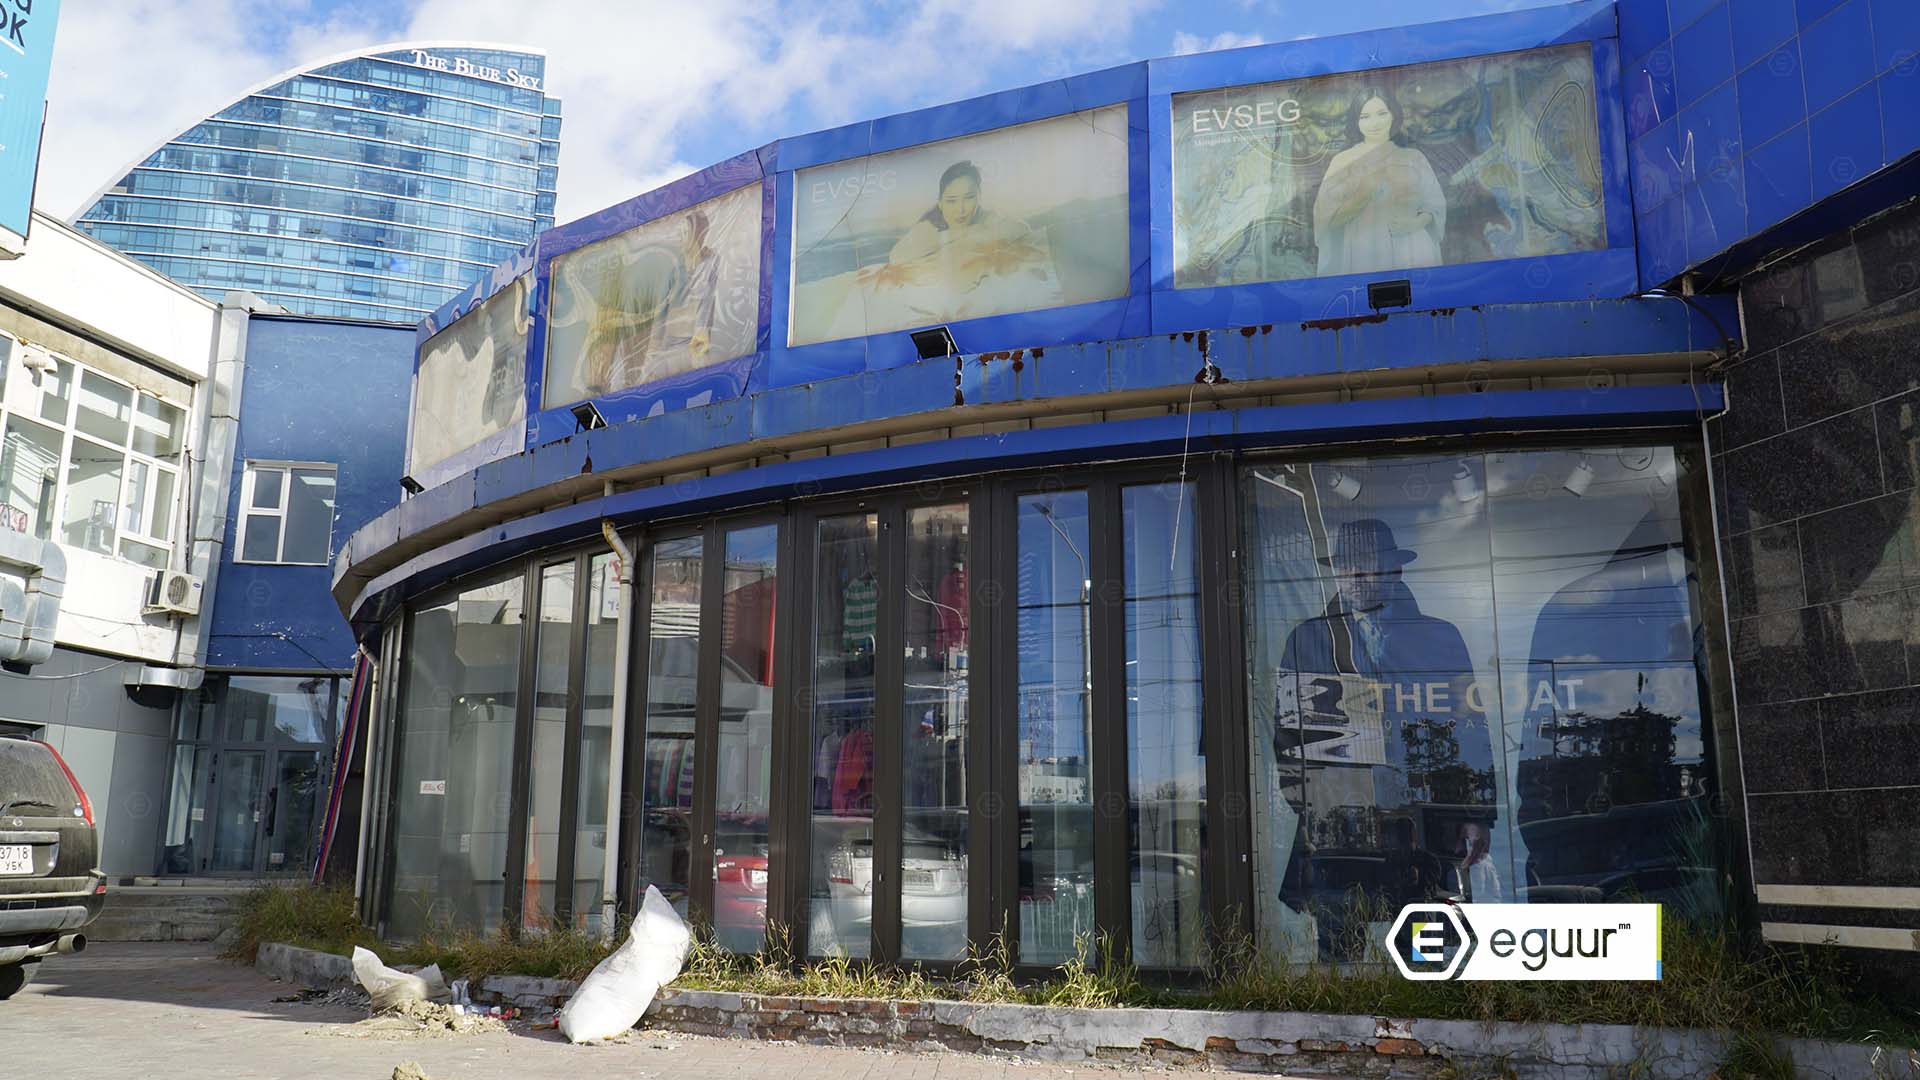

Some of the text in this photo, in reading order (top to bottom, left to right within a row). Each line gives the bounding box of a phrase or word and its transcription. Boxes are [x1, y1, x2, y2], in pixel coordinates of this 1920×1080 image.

[454, 57, 500, 81] BLUE
[1193, 99, 1301, 133] EVSEG
[812, 169, 897, 203] EVSEG
[1367, 682, 1451, 712] THE
[1447, 716, 1588, 730] CASMERE
